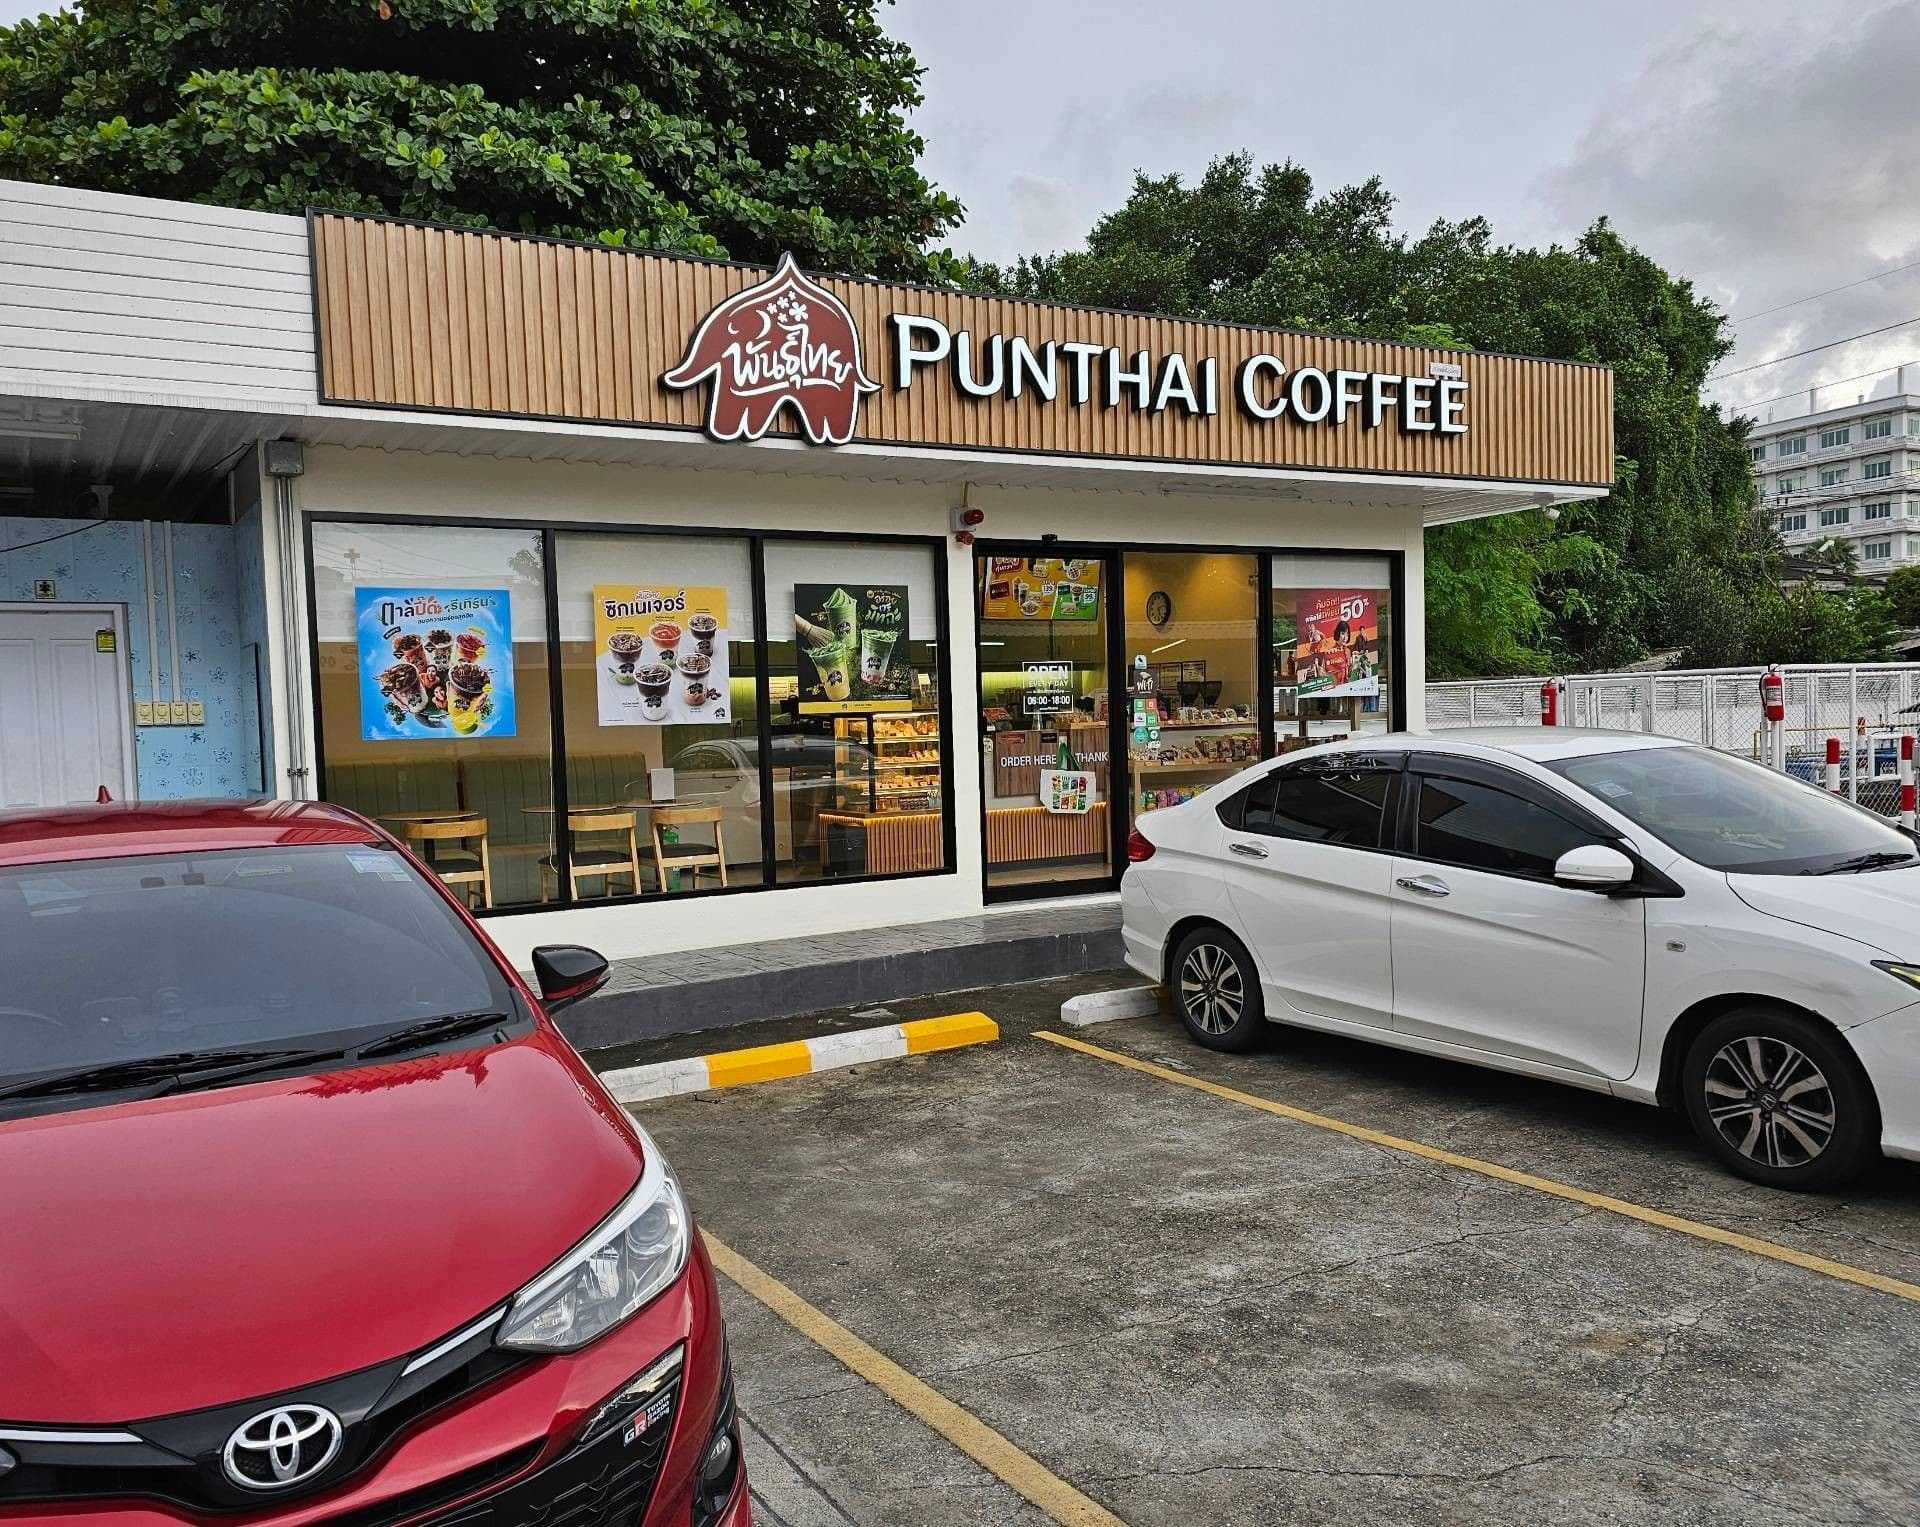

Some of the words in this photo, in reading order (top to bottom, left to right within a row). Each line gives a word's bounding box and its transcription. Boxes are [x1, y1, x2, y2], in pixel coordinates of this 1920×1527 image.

[722, 322, 853, 390] พันธุ์ไทย
[892, 313, 1217, 415] PUNTHAI
[1241, 354, 1470, 433] COFFEE
[605, 591, 685, 618] ซิกเนเจอร์
[1027, 665, 1069, 680] OPEN
[1000, 756, 1032, 768] ORDER
[1033, 754, 1057, 765] HERE
[1075, 751, 1109, 762] THANK
